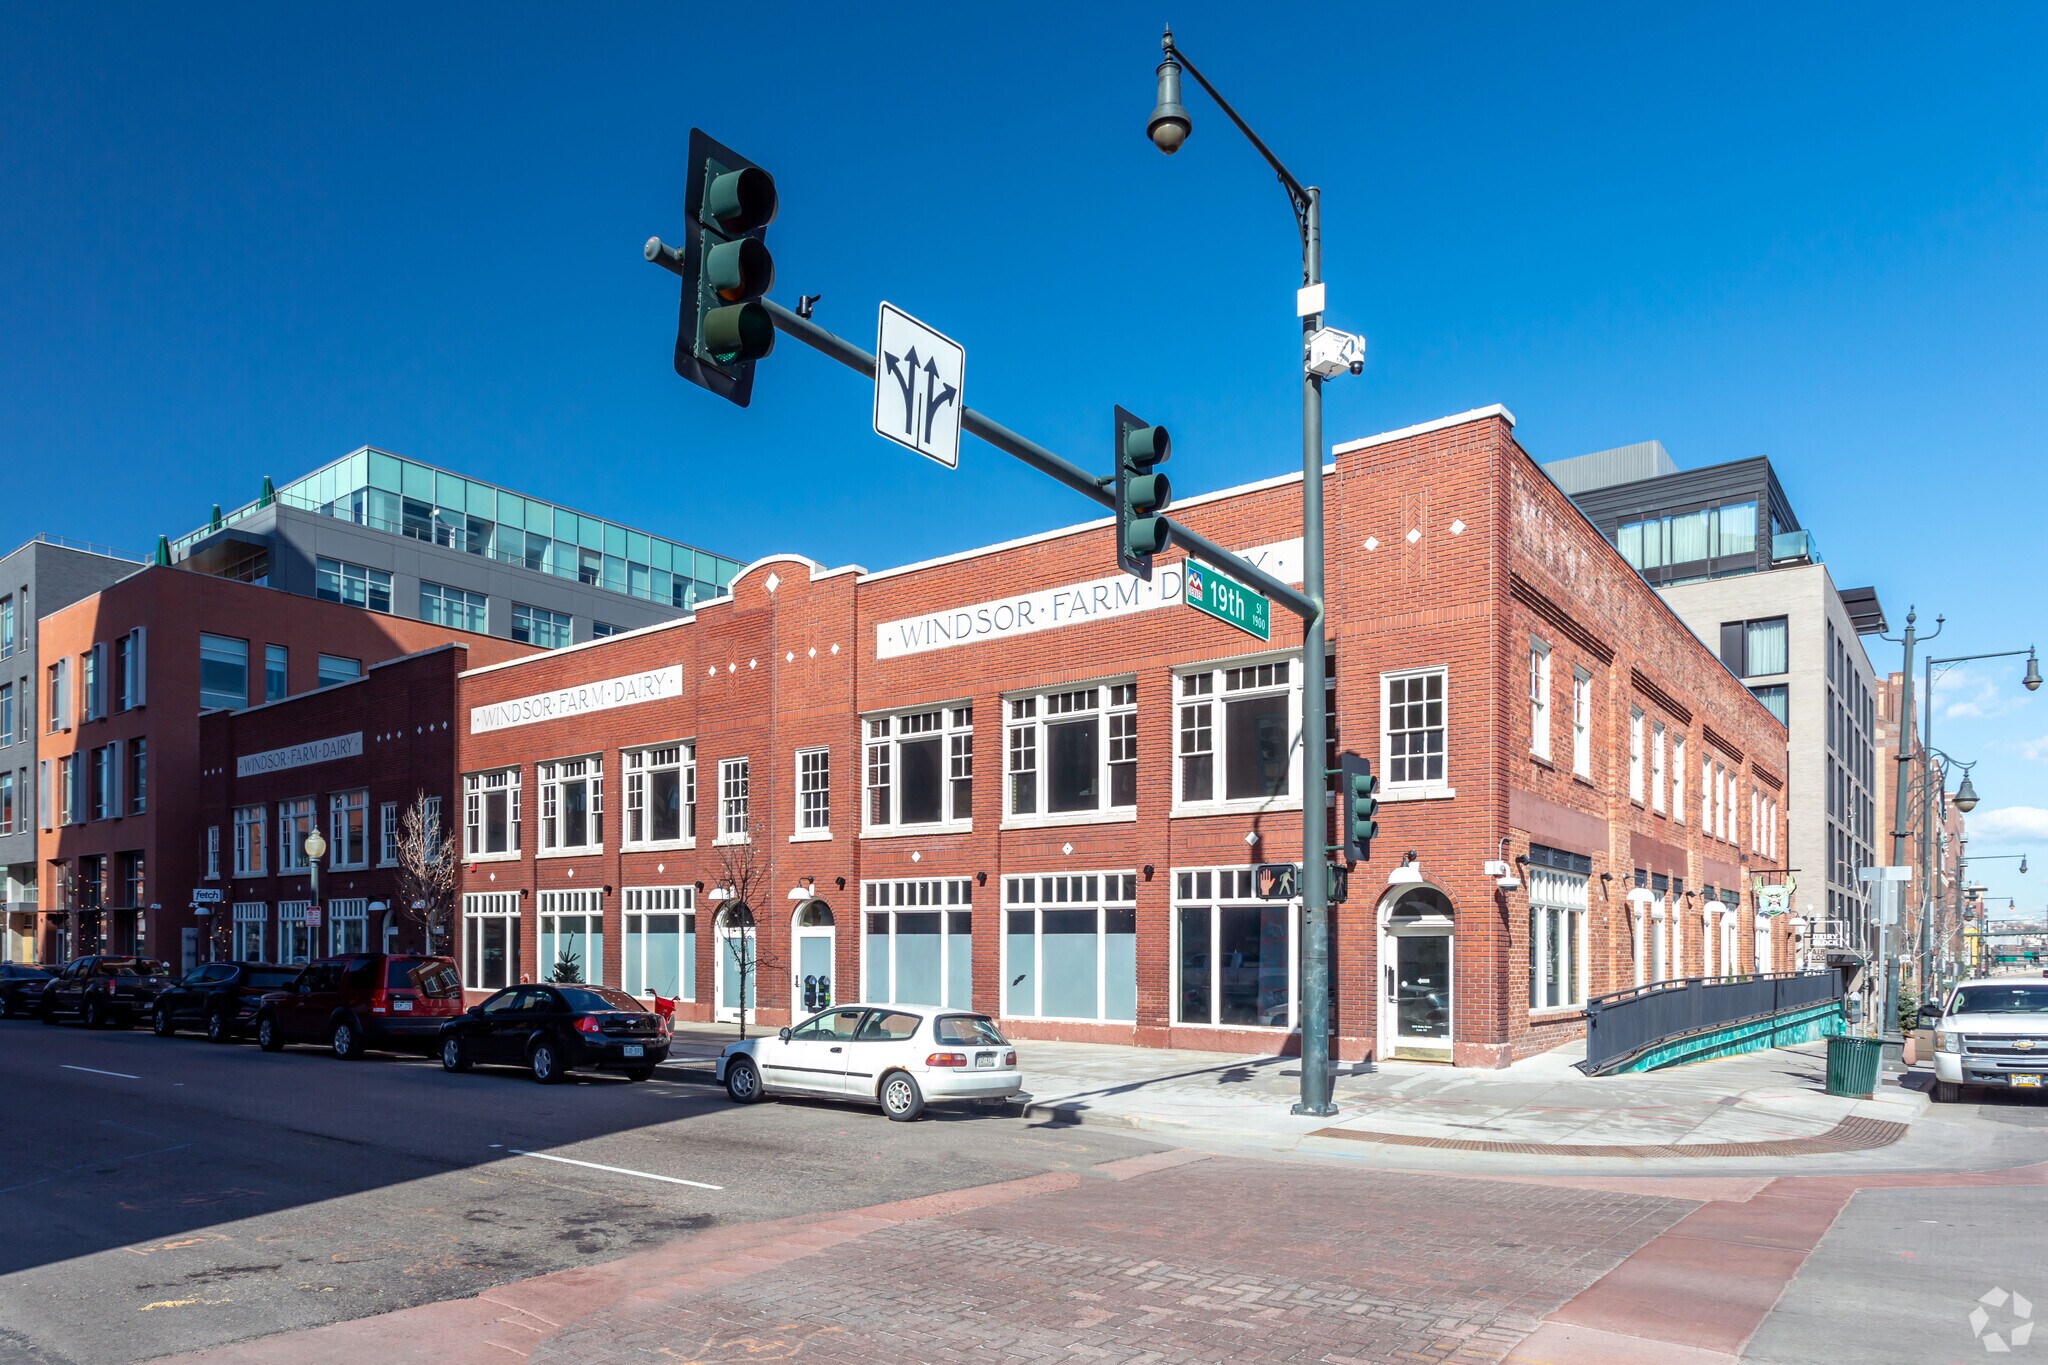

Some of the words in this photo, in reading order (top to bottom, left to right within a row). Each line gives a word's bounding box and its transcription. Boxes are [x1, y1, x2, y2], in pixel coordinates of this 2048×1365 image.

[900, 600, 1035, 649] WINDSOR
[1052, 577, 1140, 621] FARM
[1210, 580, 1245, 621] 19th
[1256, 603, 1262, 615] St
[1252, 614, 1266, 630] 1900
[482, 696, 553, 727] WINDSOR
[559, 685, 605, 714] FARM
[613, 672, 667, 703] DAIRY
[243, 751, 287, 773] WINDSOR
[291, 744, 318, 764] FARM
[323, 737, 353, 758] DAIRY
[195, 890, 219, 900] fetch
